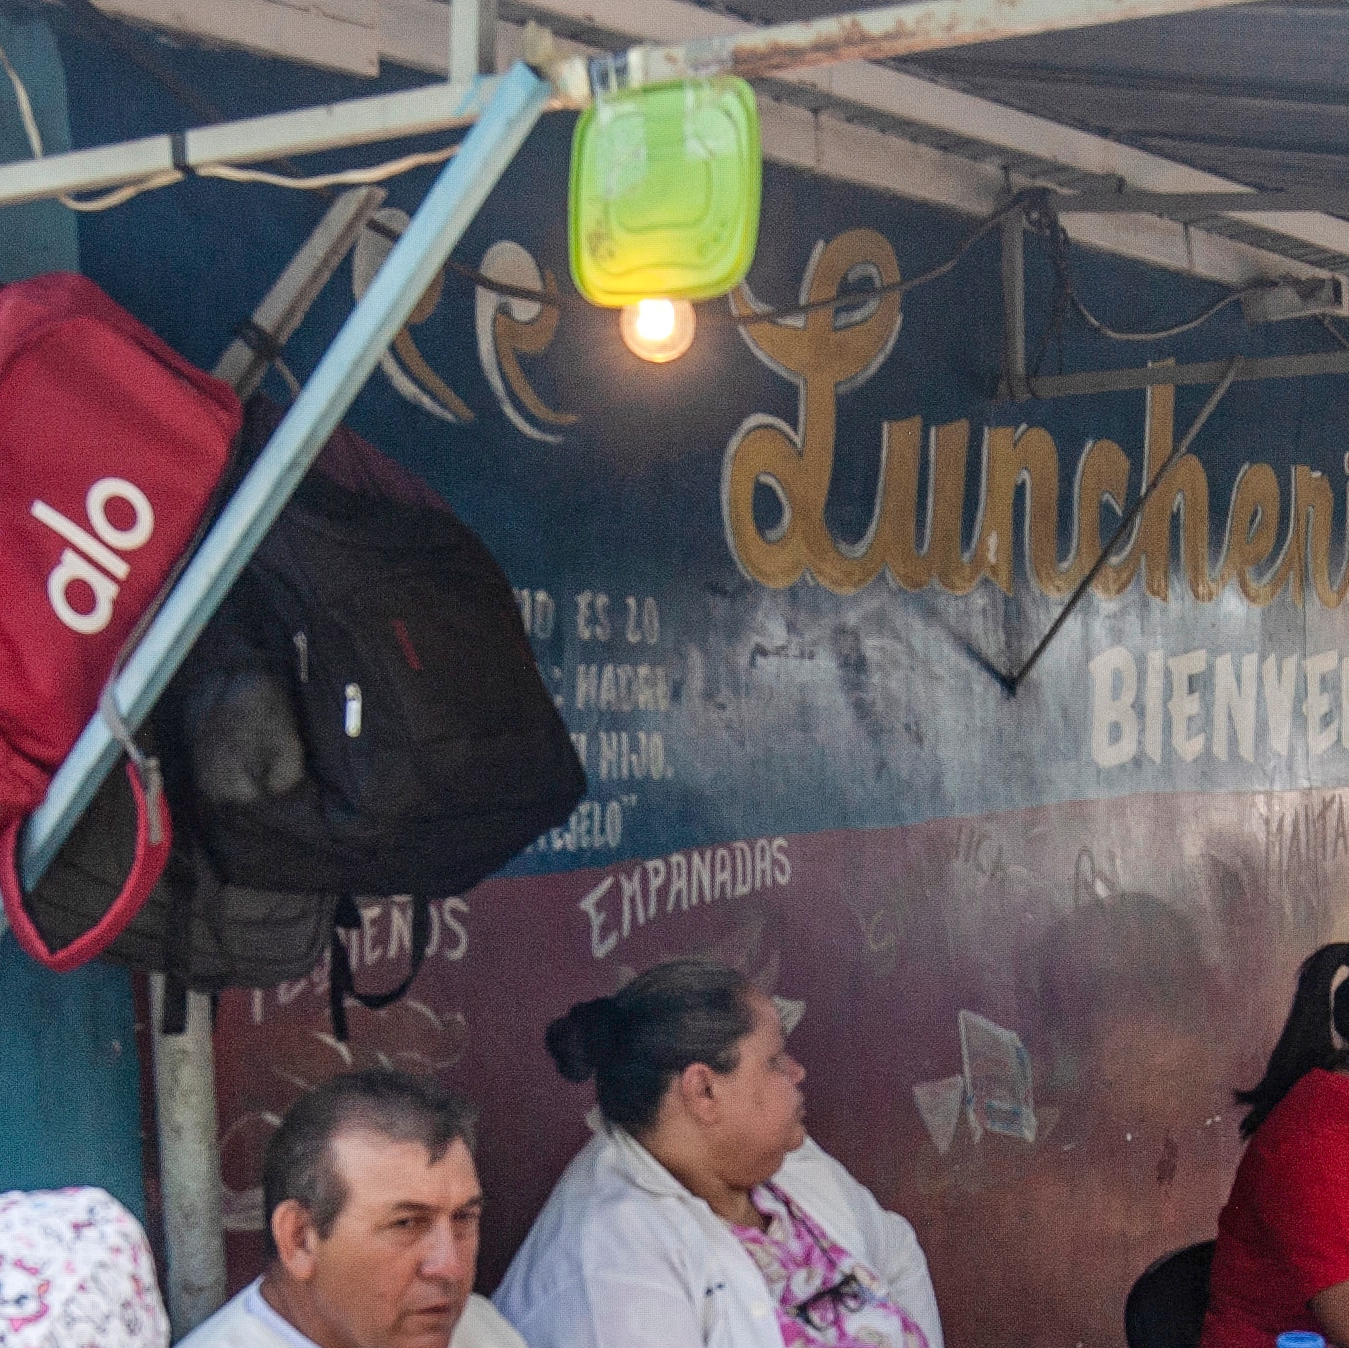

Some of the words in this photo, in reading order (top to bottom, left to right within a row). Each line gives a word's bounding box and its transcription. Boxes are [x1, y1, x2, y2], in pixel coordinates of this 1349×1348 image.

[30, 476, 156, 635] alo
[574, 589, 611, 641] ES
[579, 836, 793, 960] EMPANADAS
